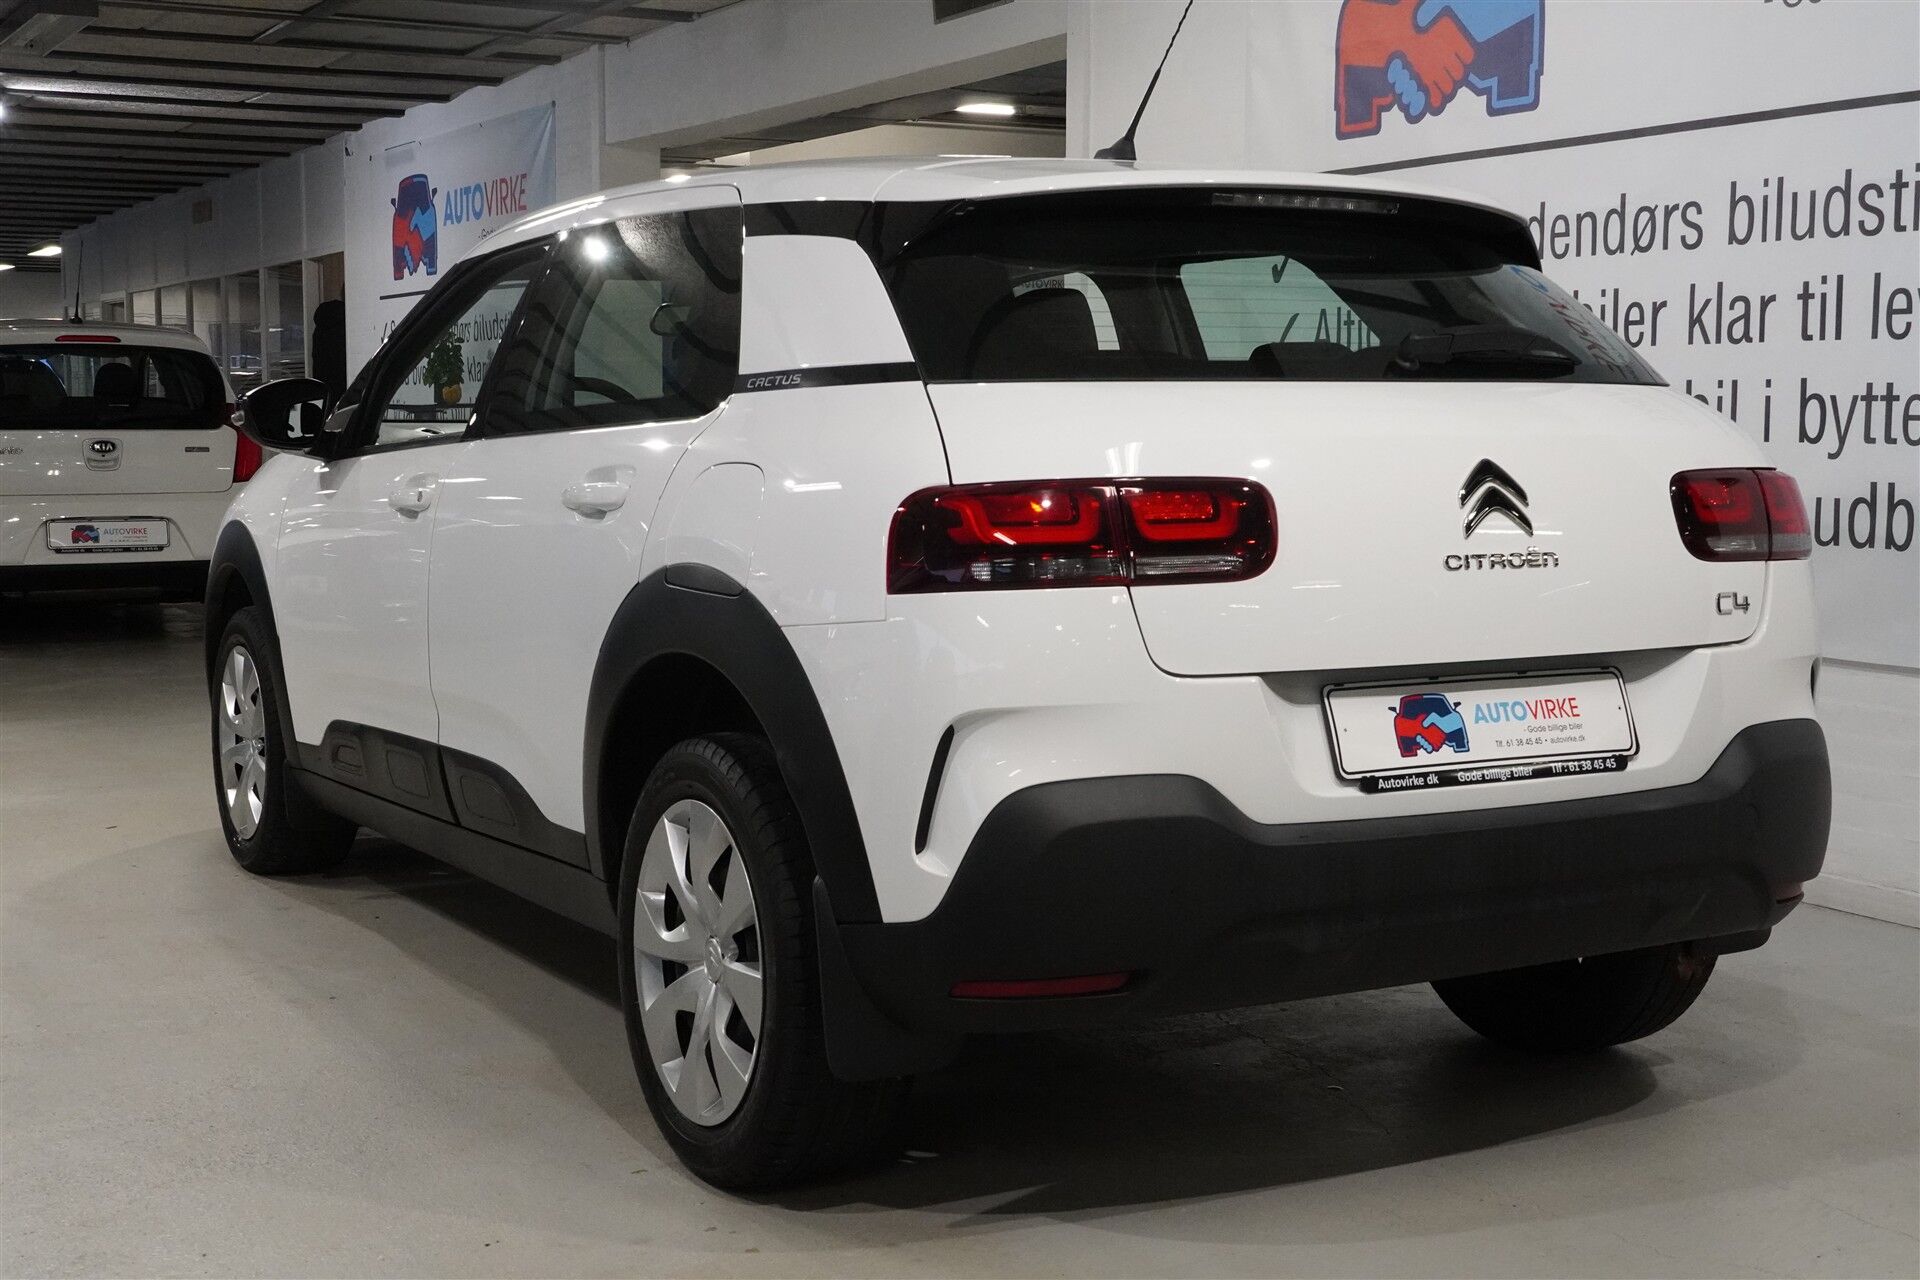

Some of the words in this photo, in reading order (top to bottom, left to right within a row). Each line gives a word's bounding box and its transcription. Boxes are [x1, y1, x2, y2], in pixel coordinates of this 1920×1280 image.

[443, 173, 527, 227] AUTOVIRKE
[1687, 278, 1777, 345] klar
[1797, 274, 1844, 342] til
[1871, 272, 1920, 341] le
[747, 373, 802, 388] CACTUS
[1763, 378, 1772, 442] i
[1798, 377, 1920, 460] bytte
[94, 442, 114, 451] KIA
[1814, 481, 1915, 552] udb
[103, 527, 148, 535] AUTOVIRKE
[1715, 592, 1751, 616] C4
[1474, 697, 1582, 724] AUTOVIRKE
[1581, 760, 1593, 771] 38
[1593, 759, 1605, 770] 45
[1605, 758, 1617, 769] 45
[1378, 775, 1425, 789] Autovirke
[1426, 773, 1439, 784] dk
[1457, 769, 1483, 782] Gode
